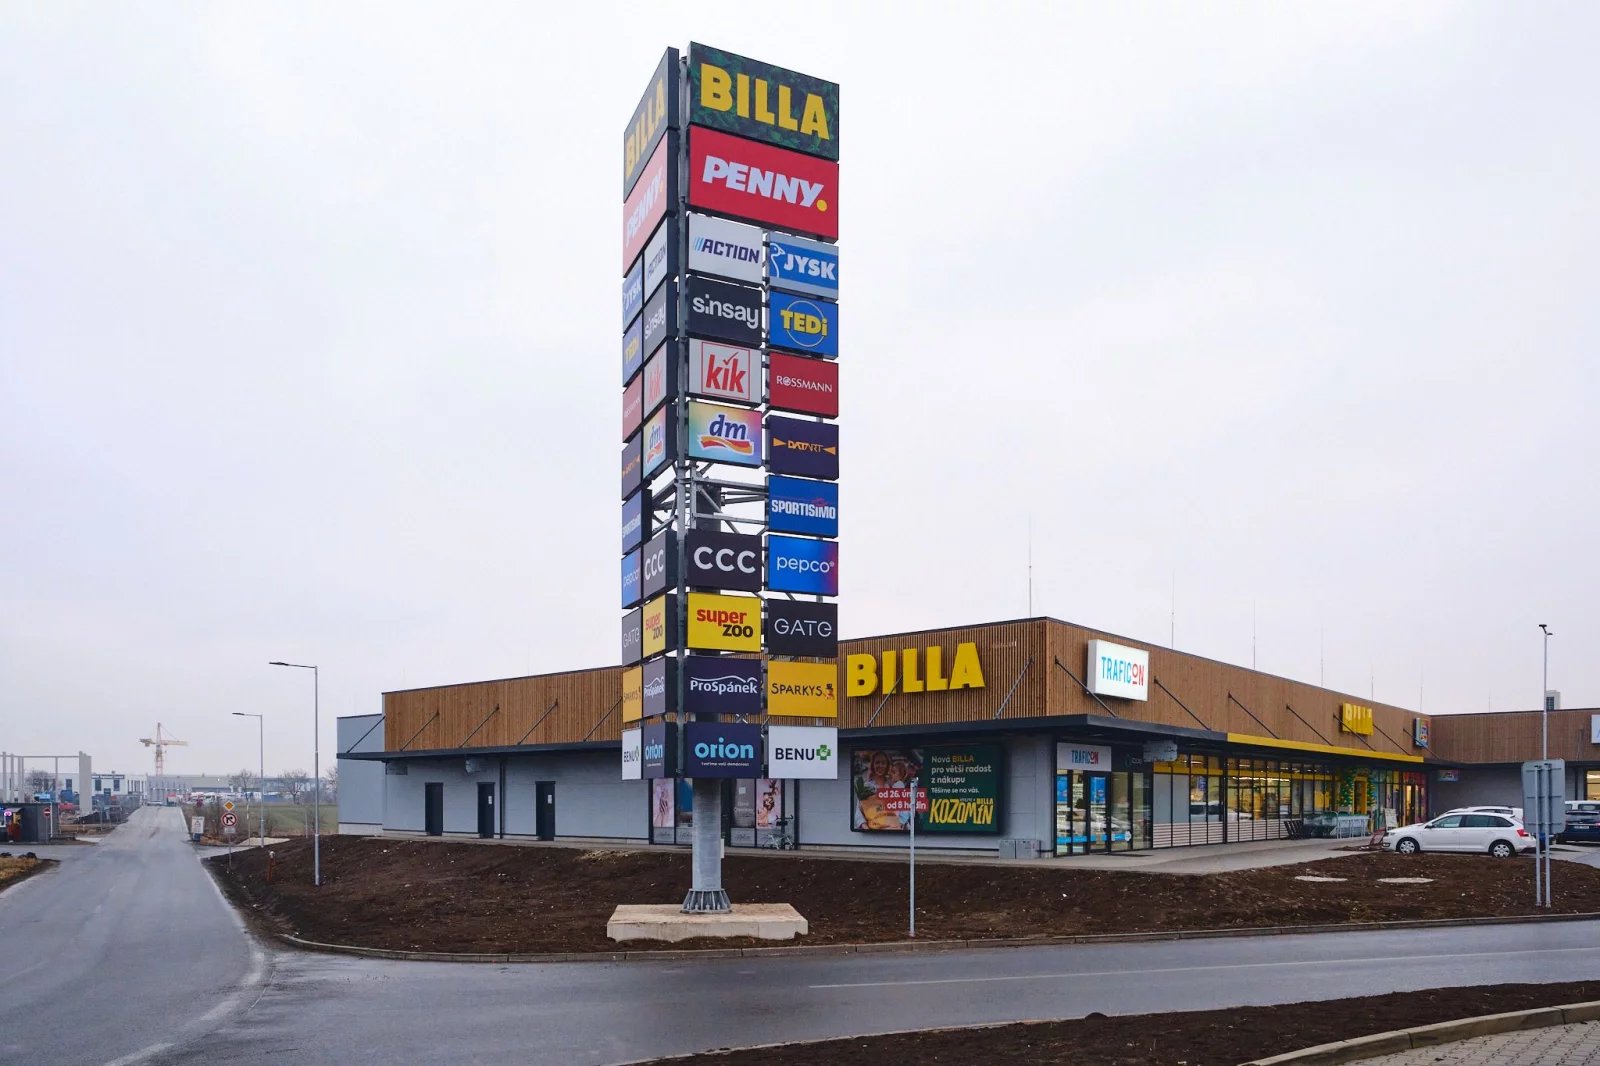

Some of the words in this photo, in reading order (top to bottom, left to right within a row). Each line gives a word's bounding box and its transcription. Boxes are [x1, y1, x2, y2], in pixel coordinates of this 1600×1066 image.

[701, 63, 829, 140] BILLA
[626, 78, 665, 181] BILLA
[701, 238, 760, 264] ACTION
[783, 253, 836, 281] JYSK
[644, 302, 666, 340] sinsay
[692, 294, 759, 329] sinsay
[780, 309, 828, 337] TEDi
[705, 352, 747, 393] kik
[776, 375, 833, 393] ROSSMANN
[709, 414, 747, 440] dm
[647, 424, 661, 452] dm
[787, 440, 823, 453] DATART
[771, 499, 836, 520] SPORTISIMO
[644, 548, 664, 581] CCC
[693, 546, 756, 574] CCC
[645, 612, 662, 632] super
[696, 608, 747, 627] super
[652, 624, 664, 641] zoo
[722, 624, 754, 638] zoo
[846, 642, 986, 697] BILLA
[1101, 656, 1145, 686] TRAFICON
[690, 679, 758, 695] ProSpánek
[771, 683, 823, 697] SPARKYS
[645, 738, 663, 761] orion
[694, 737, 754, 759] orion
[775, 747, 815, 761] BENU
[1071, 749, 1099, 765] TRAFICON
[931, 766, 945, 775] pro
[965, 764, 992, 773] radost
[952, 755, 975, 763] BILLA
[936, 776, 966, 785] nákupu
[878, 790, 889, 799] od
[886, 800, 897, 809] od
[897, 800, 903, 809] 8
